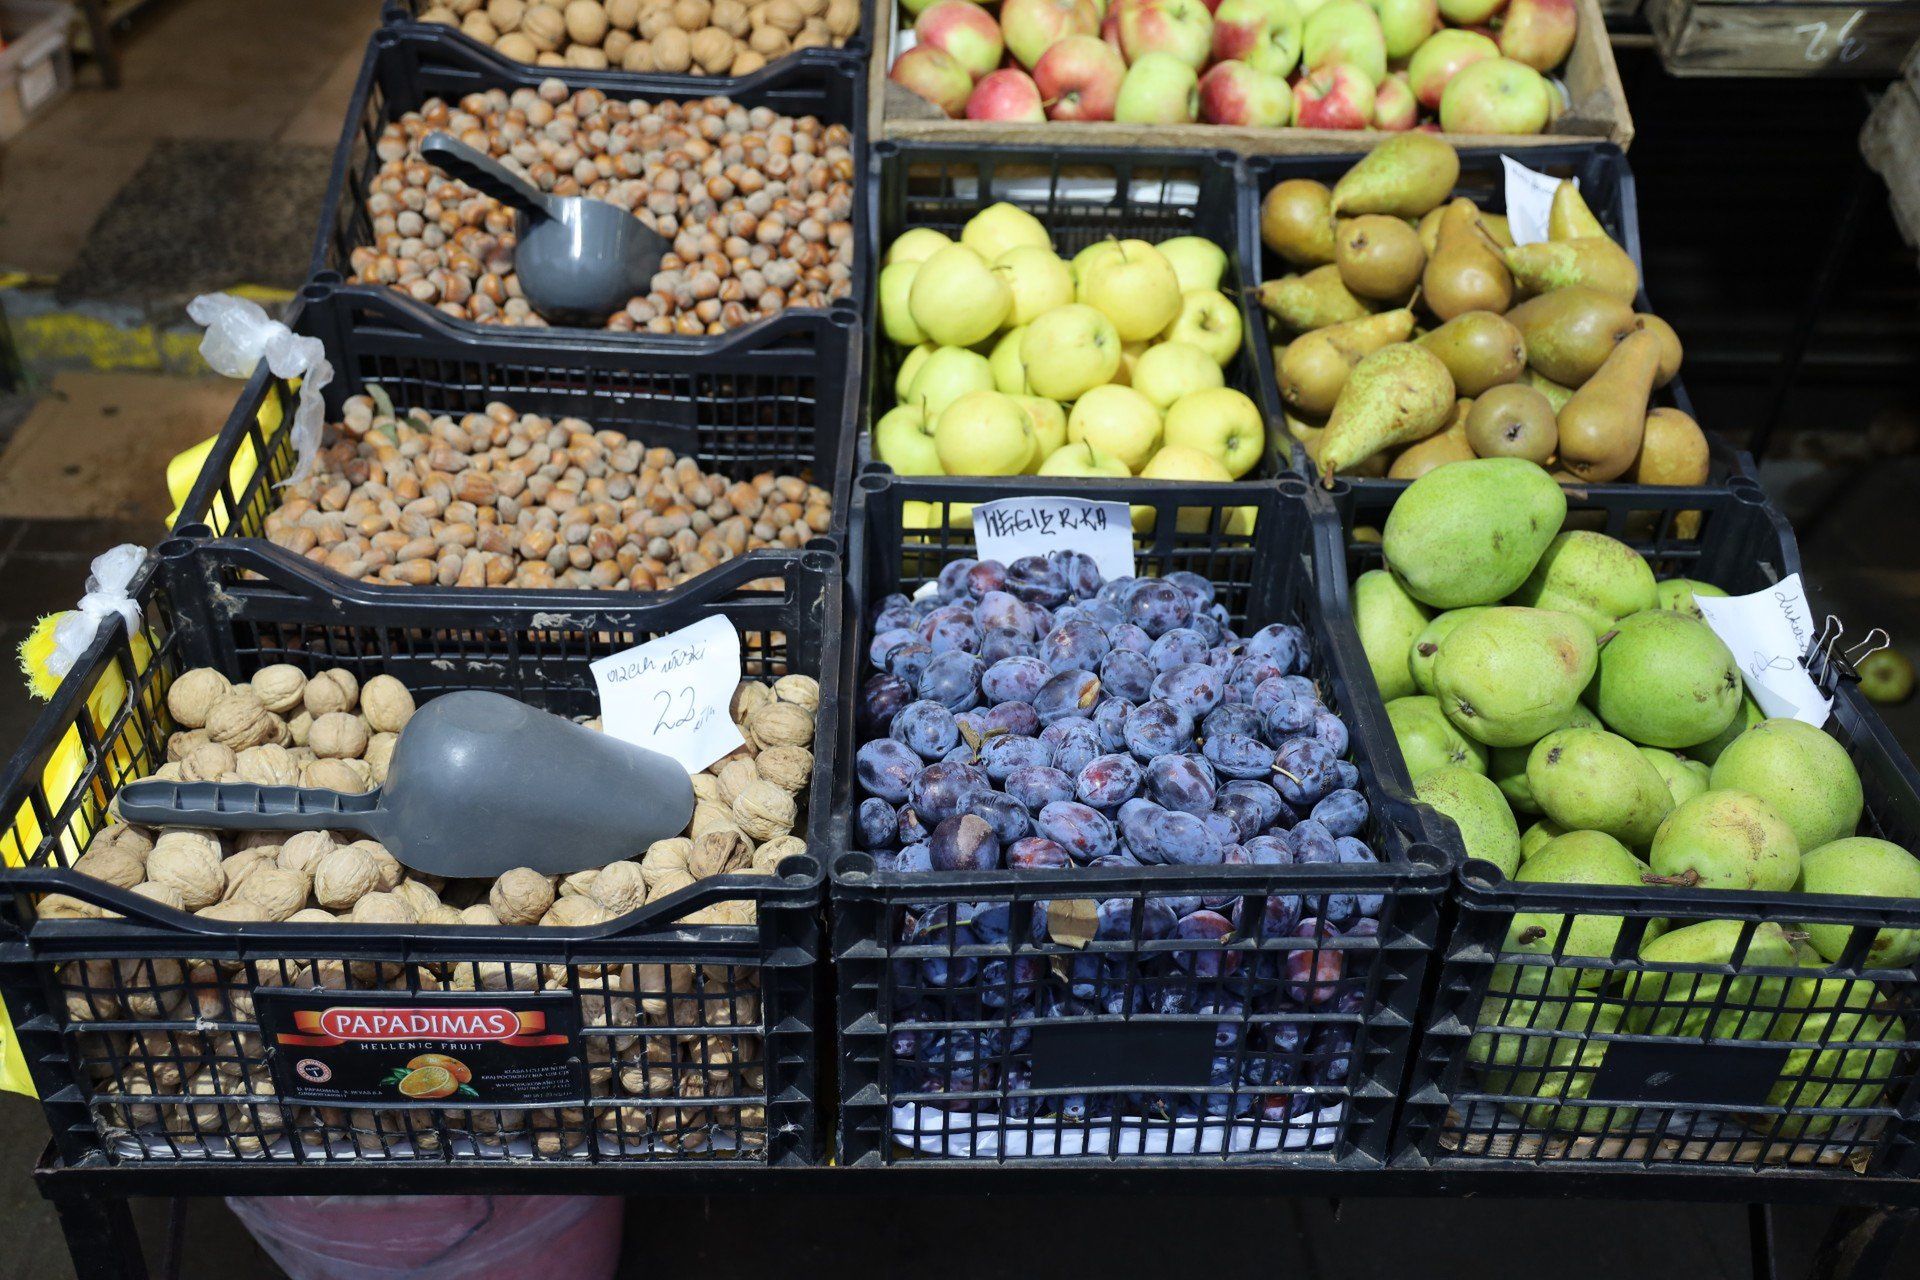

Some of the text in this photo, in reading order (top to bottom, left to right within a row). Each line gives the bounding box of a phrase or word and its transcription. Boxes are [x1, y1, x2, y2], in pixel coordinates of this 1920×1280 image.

[653, 686, 696, 736] 22
[336, 1014, 507, 1034] PAPADIMAS
[360, 1042, 433, 1050] HELLENIC
